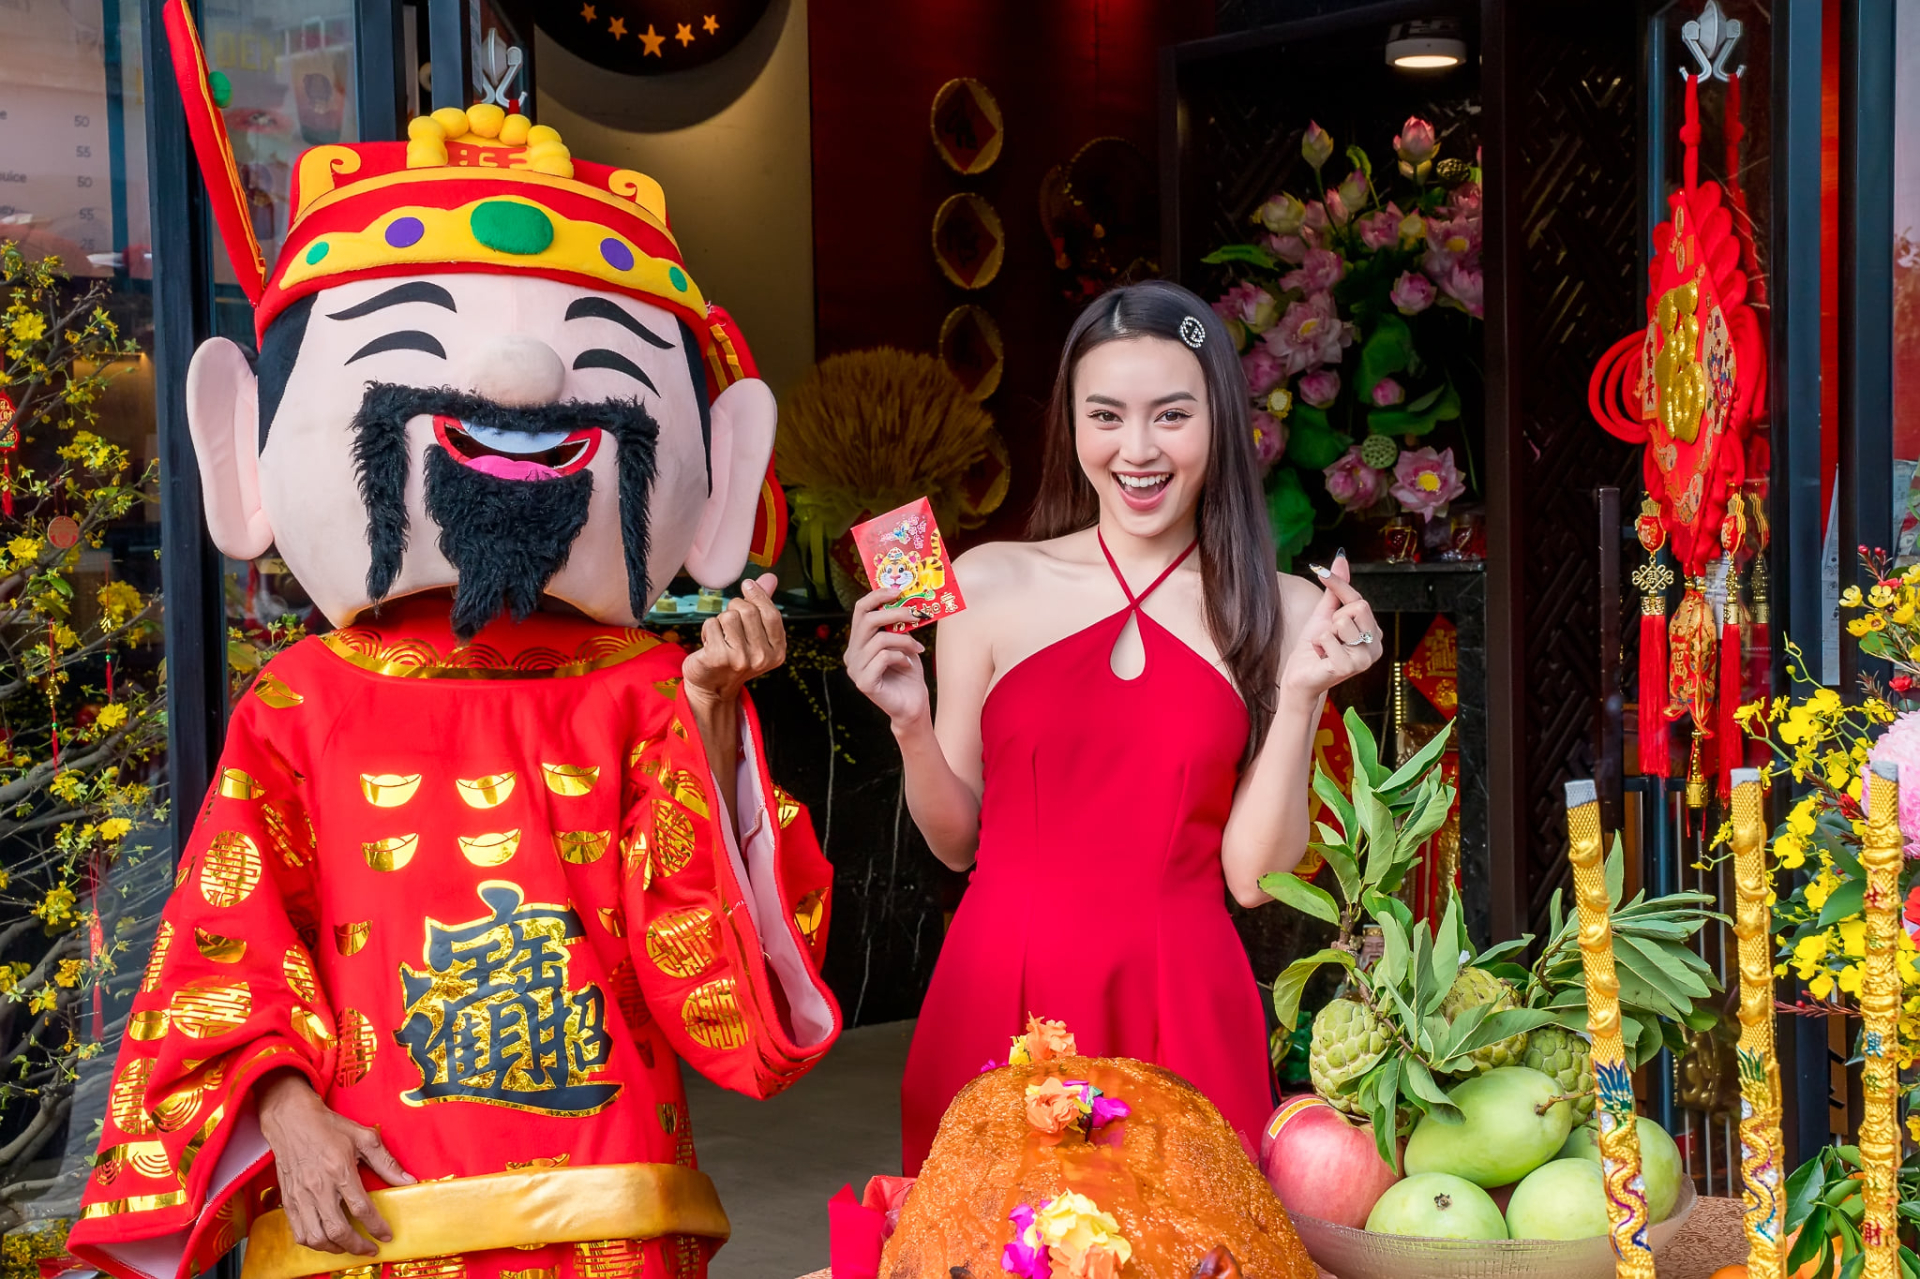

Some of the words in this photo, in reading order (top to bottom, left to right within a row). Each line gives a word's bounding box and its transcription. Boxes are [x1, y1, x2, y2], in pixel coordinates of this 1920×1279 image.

[74, 115, 90, 127] 50
[76, 145, 92, 158] 55
[77, 175, 93, 188] 50
[79, 207, 95, 221] 55
